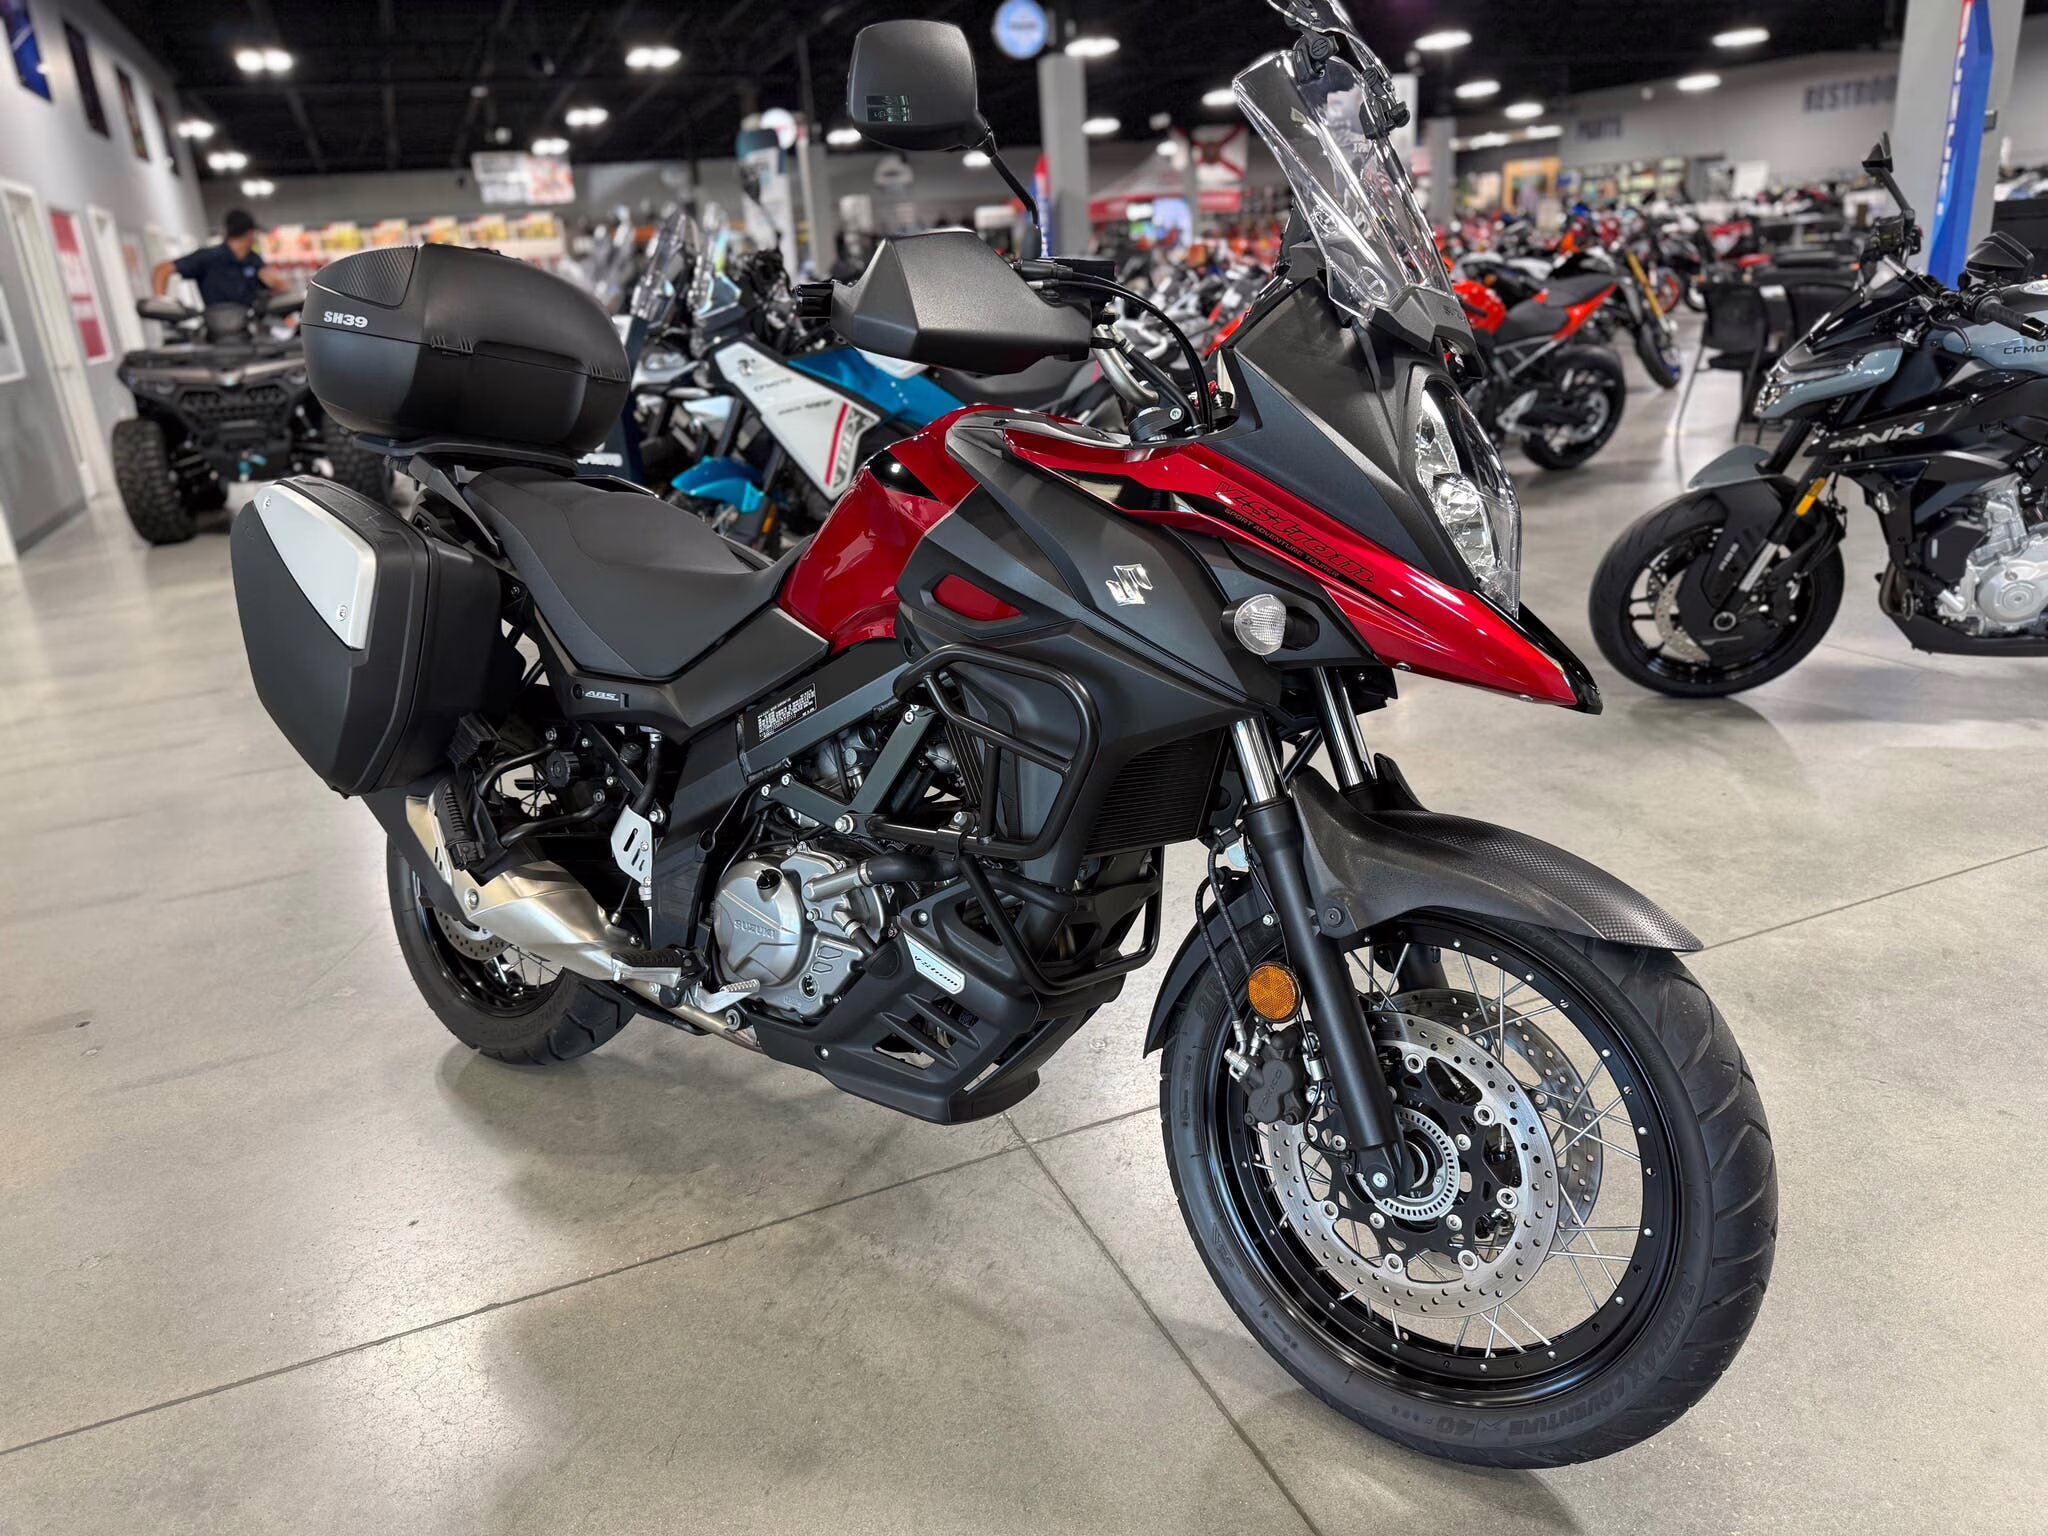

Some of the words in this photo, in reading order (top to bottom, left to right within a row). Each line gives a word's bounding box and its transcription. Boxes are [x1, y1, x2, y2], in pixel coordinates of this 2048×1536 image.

[323, 311, 368, 328] SH39
[2003, 344, 2048, 355] CFMO
[1224, 507, 1252, 527] SPORT
[1253, 524, 1303, 557] ADVENTURE
[1304, 554, 1340, 578] TOURER
[585, 690, 619, 701] ABS
[734, 919, 776, 940] SUZUKI
